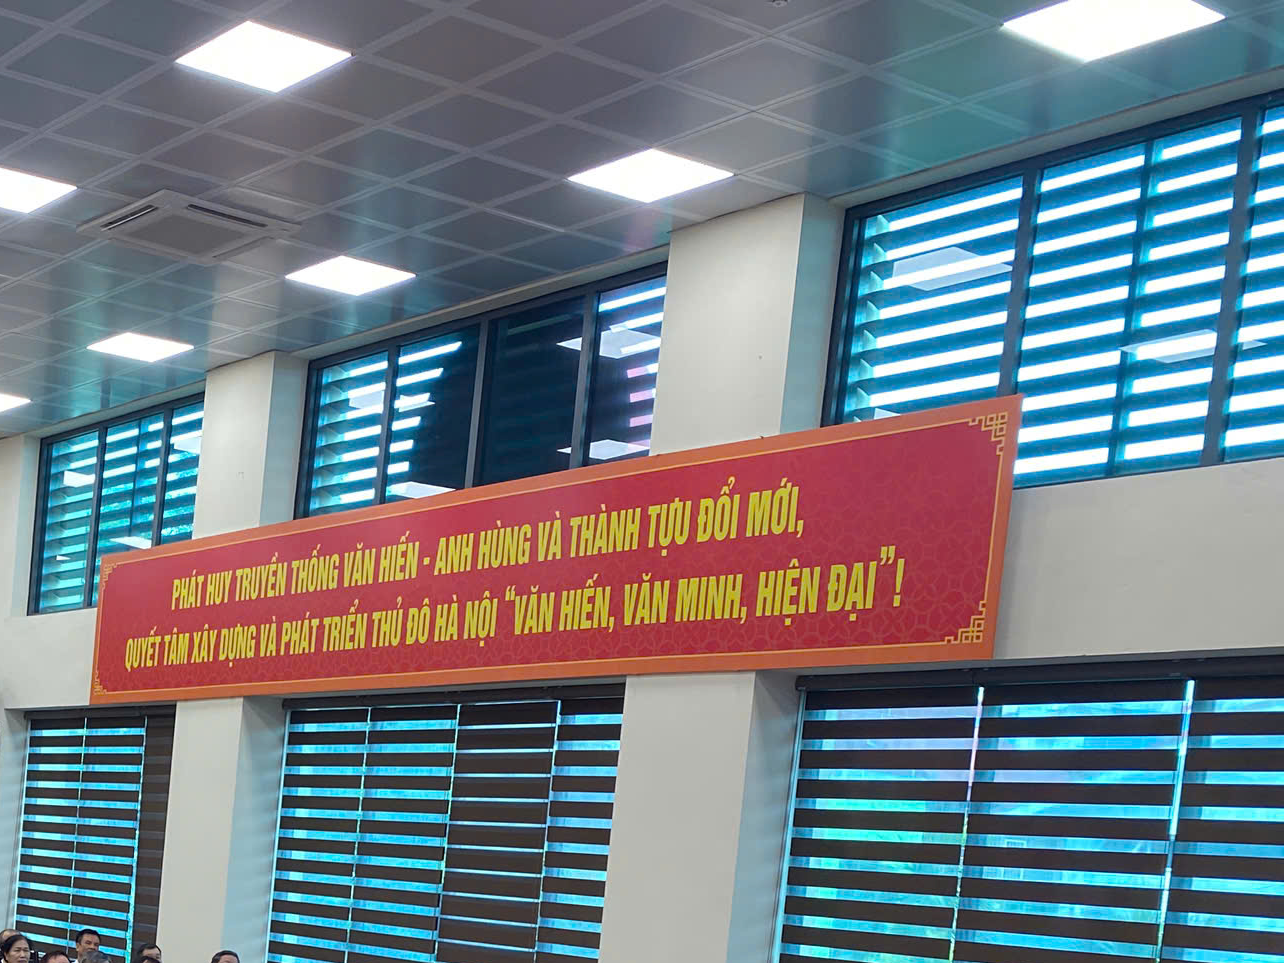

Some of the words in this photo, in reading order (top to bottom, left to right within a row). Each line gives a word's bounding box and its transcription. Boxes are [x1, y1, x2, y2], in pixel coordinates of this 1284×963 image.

[171, 568, 204, 610] PHÁT
[206, 570, 232, 606] HUY
[235, 552, 288, 601] TRUYỀN
[290, 544, 339, 595] THỐNG
[343, 542, 376, 587] VĂN
[378, 531, 420, 583] HIẾN
[423, 557, 430, 566] -
[434, 533, 474, 576] ANH
[478, 520, 532, 570] HÙNG
[537, 511, 562, 562] VÀ
[570, 504, 642, 558] THÀNH
[648, 498, 692, 556] TỰU
[696, 476, 740, 542] ĐỔI
[746, 478, 804, 538] MỚI,
[124, 626, 161, 672] QUYẾT
[163, 627, 190, 666] TÂM
[190, 624, 218, 663] XÂY
[218, 623, 256, 667] DỰNG
[260, 616, 277, 656] VÀ
[280, 612, 320, 655] PHÁT
[322, 600, 368, 652] TRIỂN
[372, 597, 404, 648] THỦ
[406, 598, 430, 645] ĐÔ
[434, 594, 458, 642] HÀ
[464, 591, 498, 646] NỘI
[558, 574, 614, 632] HIẾN,
[624, 572, 670, 626] VĂN
[675, 574, 747, 624] MINH,
[756, 558, 821, 626] HIỆN
